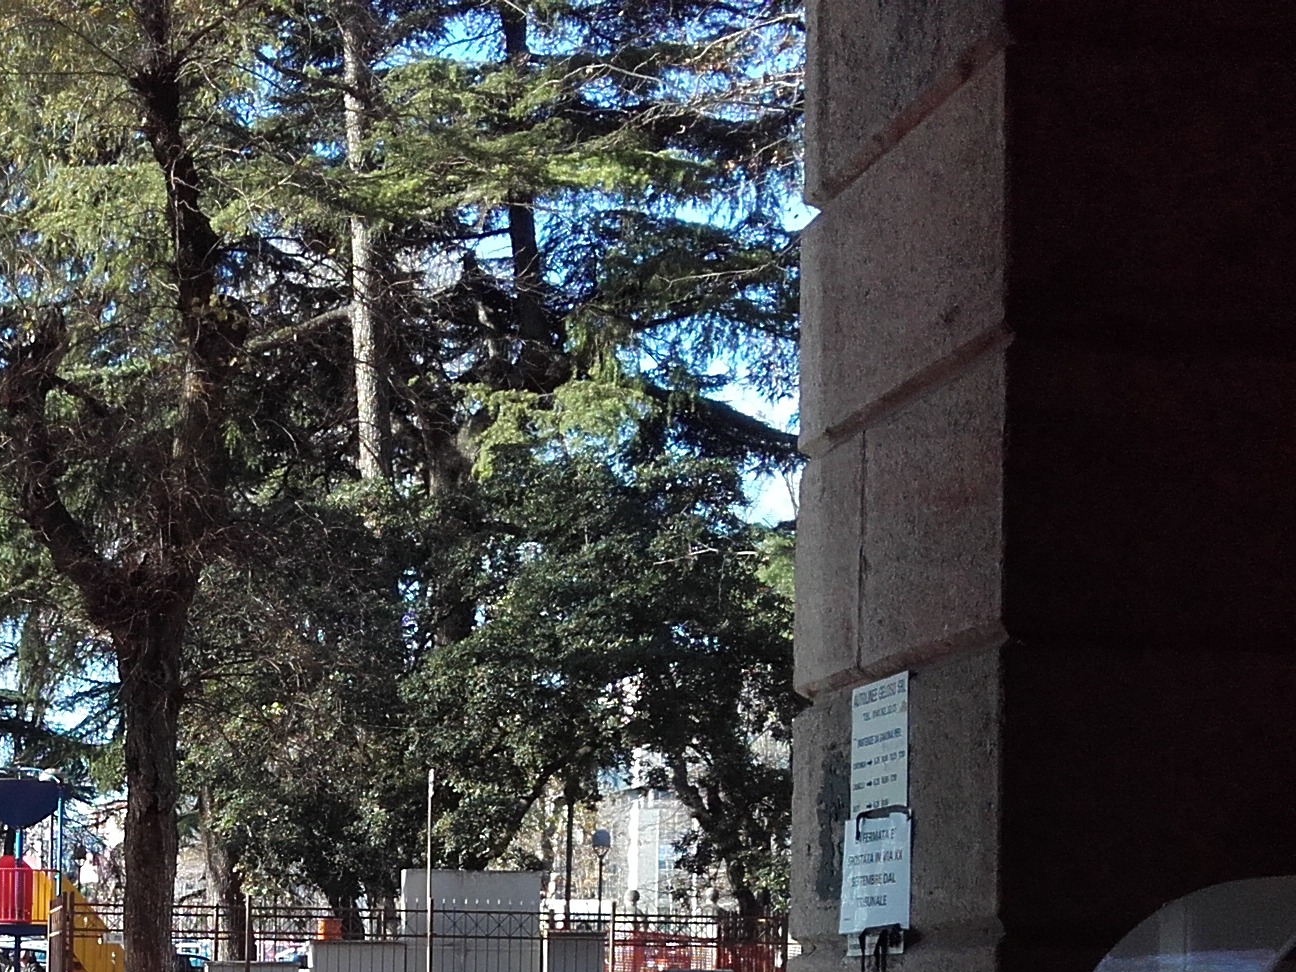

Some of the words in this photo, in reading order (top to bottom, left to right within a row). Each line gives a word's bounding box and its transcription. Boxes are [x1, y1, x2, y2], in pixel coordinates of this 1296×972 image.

[863, 829, 889, 843] FERMATA
[848, 852, 873, 866] SPOSTATA
[874, 852, 882, 863] IN
[884, 850, 893, 862] VIA
[851, 873, 882, 887] SETTEMBRE
[883, 872, 896, 884] DAL
[856, 894, 887, 907] TRIBUNALE
